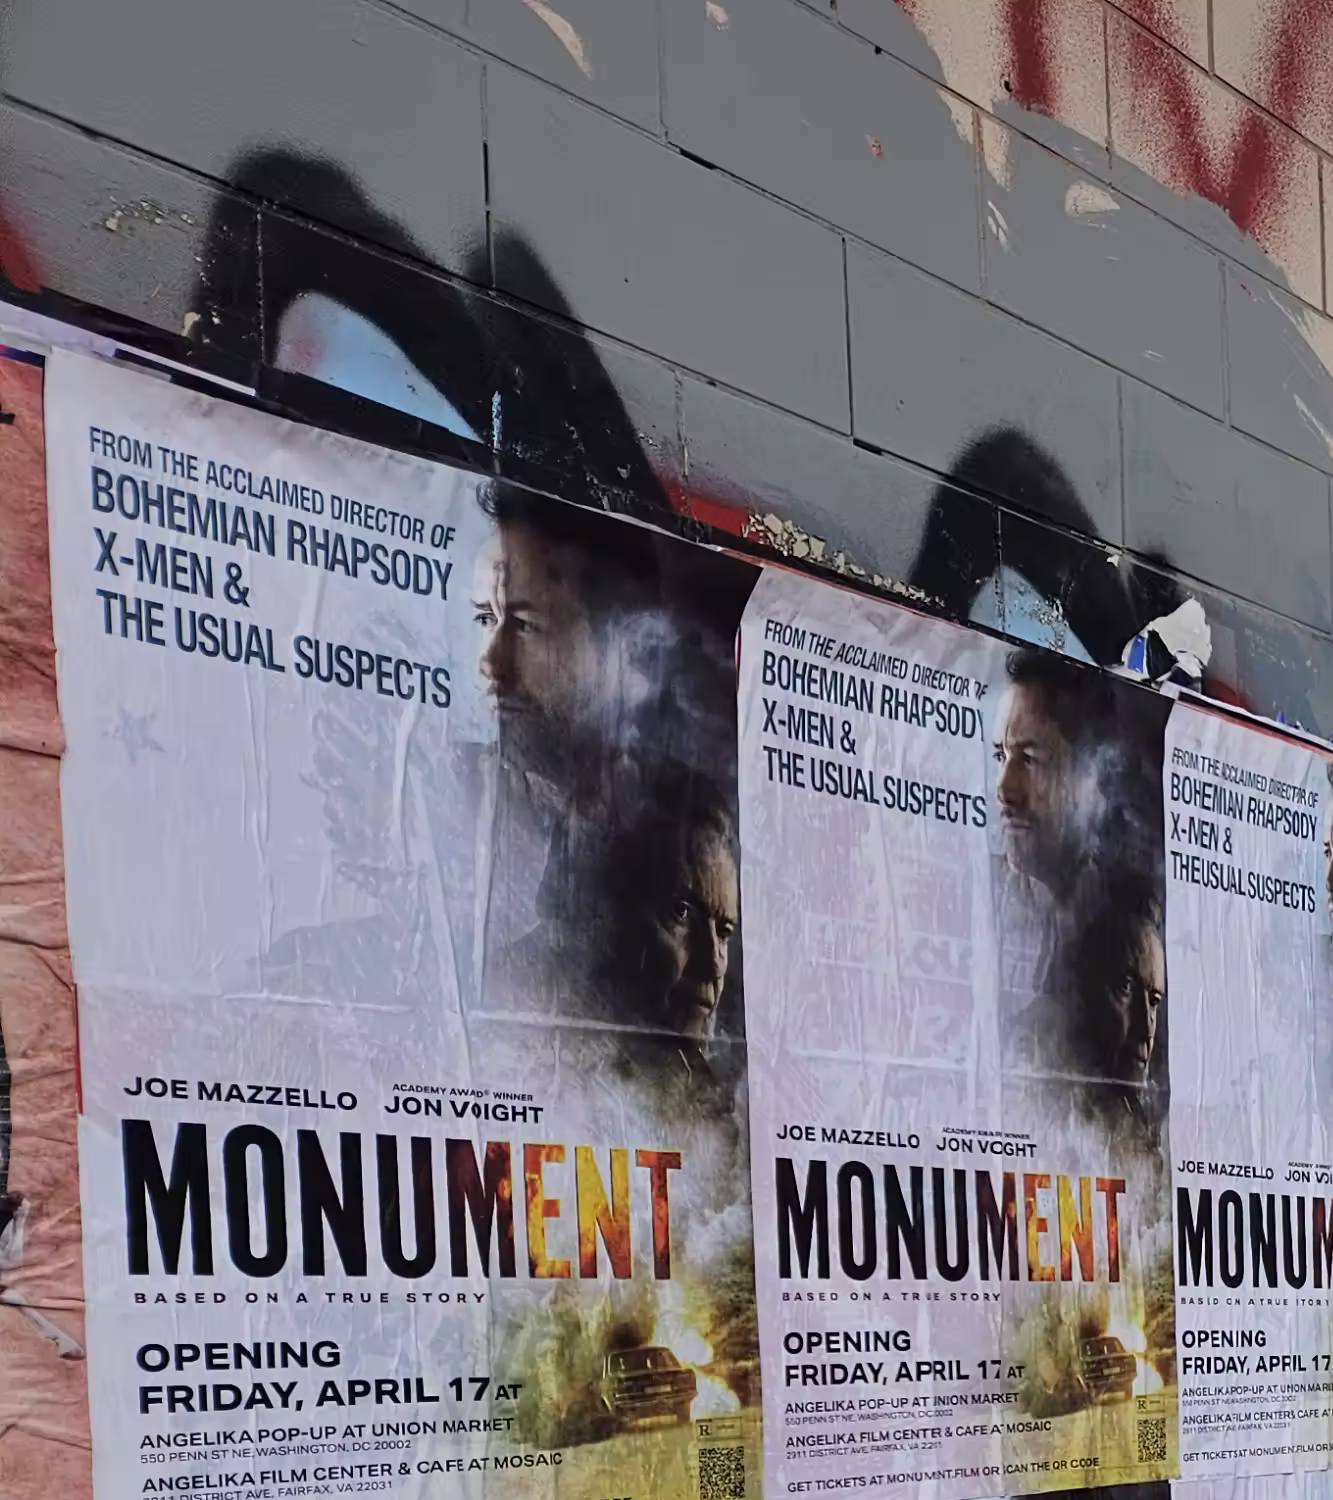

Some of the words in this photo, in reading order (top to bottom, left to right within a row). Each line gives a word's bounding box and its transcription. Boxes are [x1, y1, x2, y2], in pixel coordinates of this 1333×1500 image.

[90, 426, 152, 468] FROM
[157, 445, 198, 482] THE
[205, 460, 324, 514] ACCLAIMED
[330, 494, 424, 543] DIRECTOR
[430, 523, 455, 550] OF
[92, 467, 275, 555] BOHEMIAN
[286, 520, 451, 599] RHAPSODY
[95, 528, 213, 598] X-MEN
[223, 561, 250, 607] &
[96, 588, 165, 646] THE
[174, 607, 285, 672] USUAL
[294, 635, 450, 708] SUSPECTS
[763, 746, 804, 789] THE
[810, 753, 880, 805] USUAL
[883, 776, 987, 829] SUSPECTS
[123, 1076, 188, 1099] JOE
[197, 1081, 357, 1110] MAZZELLO
[384, 1095, 442, 1116] JON
[449, 1100, 543, 1123] VOIGHT
[392, 1083, 446, 1094] ACADEMY
[492, 1091, 533, 1101] WINNER
[121, 1119, 681, 1280] MONUMENT
[775, 1157, 1126, 1284] MONUMENT
[134, 1292, 226, 1304] BASED
[244, 1291, 278, 1303] ON
[295, 1292, 308, 1303] A
[324, 1292, 388, 1303] TRUE
[405, 1292, 484, 1303] STORY
[136, 1340, 340, 1372] OPENING
[783, 1330, 911, 1356] OPENING
[139, 1382, 301, 1413] FRIDAY,
[317, 1378, 438, 1405] APRIL
[448, 1376, 490, 1402] 17
[494, 1383, 522, 1401] AT
[139, 1429, 254, 1448] ANGELIKA
[257, 1425, 336, 1442] POP-UP
[341, 1423, 366, 1438] AT
[371, 1420, 436, 1437] UNION
[442, 1417, 514, 1433] MARKET
[140, 1453, 165, 1464] 550
[169, 1451, 207, 1462] PENN
[211, 1449, 229, 1460] ST
[352, 1441, 371, 1451] DC
[374, 1439, 411, 1450] 20002
[142, 1472, 255, 1492] ANGELIKA
[259, 1468, 307, 1484] FILM
[312, 1462, 392, 1481] CENTER
[397, 1461, 411, 1476] &
[416, 1458, 464, 1474] CAFE
[467, 1456, 490, 1471] AT
[493, 1452, 562, 1469] MOSAIC
[336, 1483, 354, 1494] VA
[357, 1481, 392, 1492] 22031
